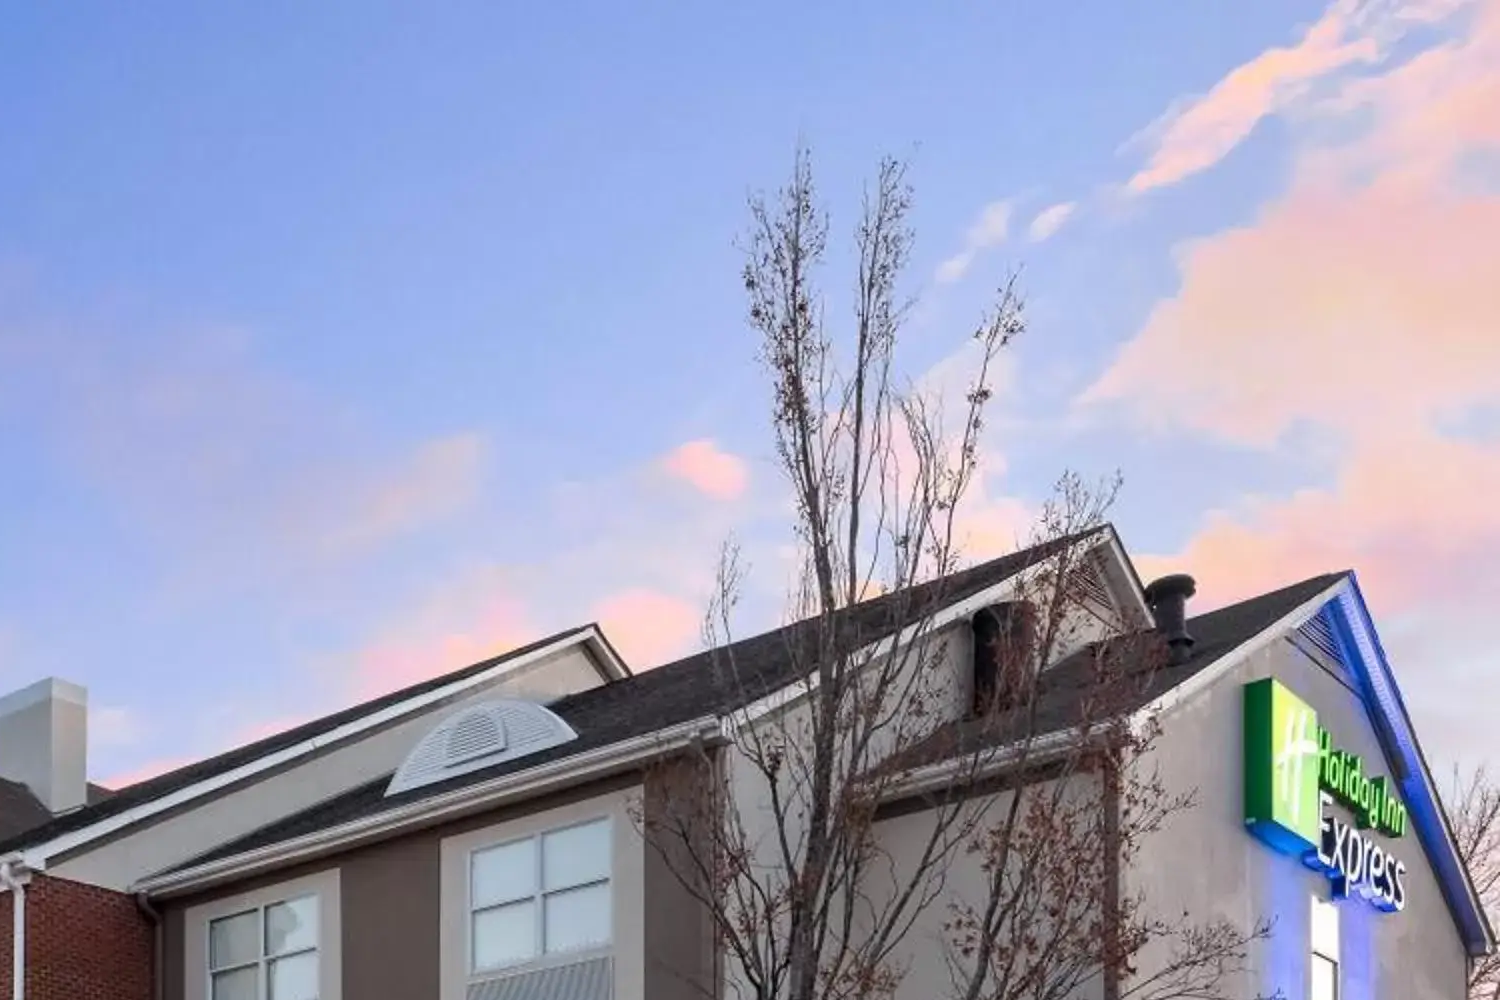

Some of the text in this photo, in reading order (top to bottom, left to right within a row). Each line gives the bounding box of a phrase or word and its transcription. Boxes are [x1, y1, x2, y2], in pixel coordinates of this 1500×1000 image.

[1317, 729, 1406, 837] Holiday Inn
[1317, 790, 1406, 911] Express
